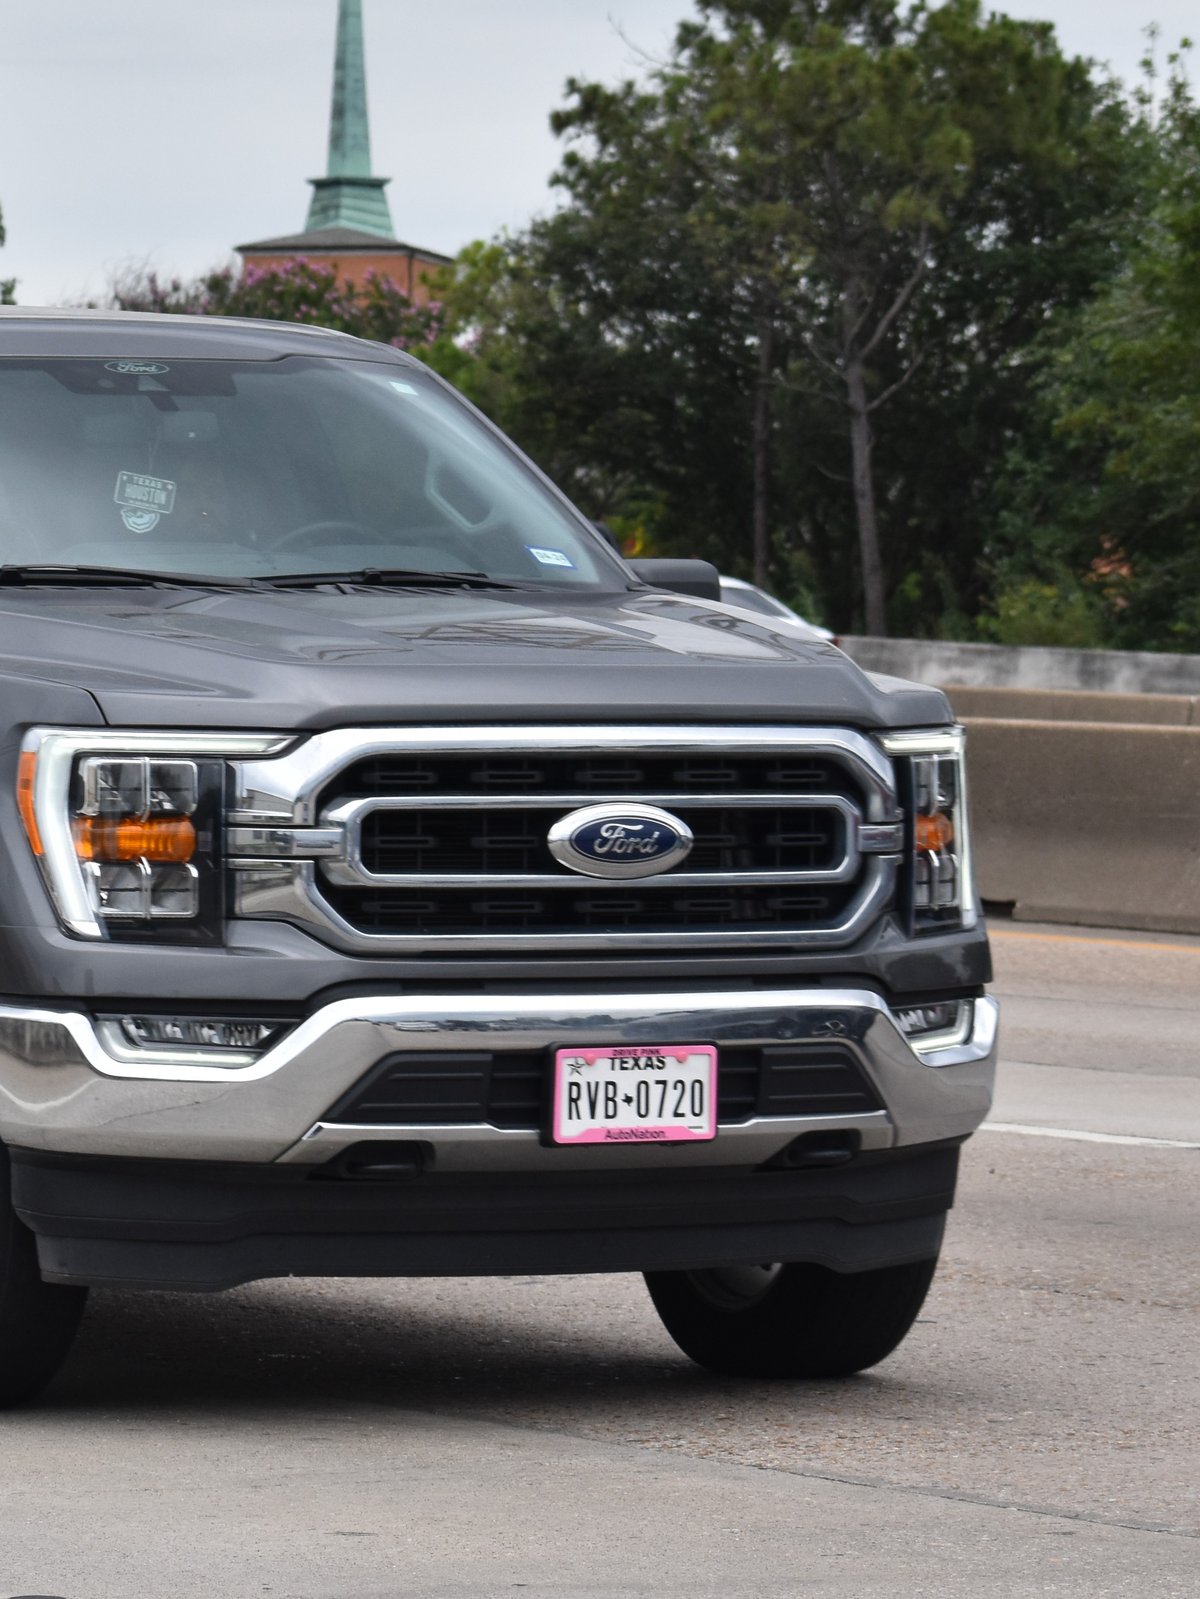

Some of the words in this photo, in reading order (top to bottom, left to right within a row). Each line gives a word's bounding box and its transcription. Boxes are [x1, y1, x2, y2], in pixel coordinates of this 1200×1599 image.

[116, 361, 159, 372] Ford
[593, 823, 660, 853] Ford
[608, 1056, 666, 1071] TEXAS
[568, 1081, 618, 1120] RVB
[636, 1079, 703, 1118] 0720
[605, 1129, 666, 1140] AutoNation
